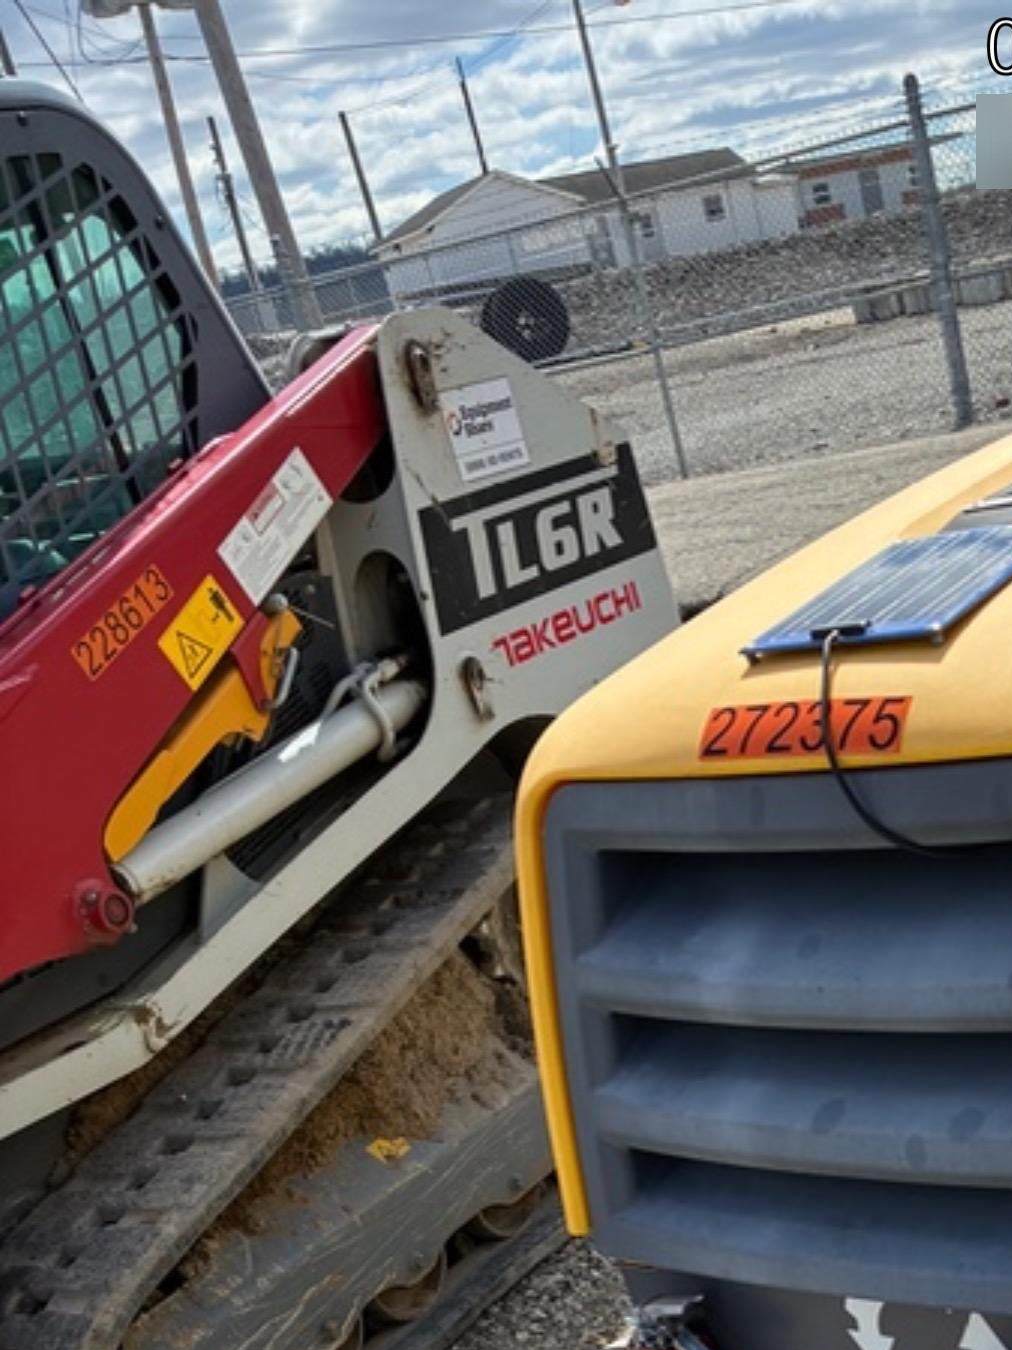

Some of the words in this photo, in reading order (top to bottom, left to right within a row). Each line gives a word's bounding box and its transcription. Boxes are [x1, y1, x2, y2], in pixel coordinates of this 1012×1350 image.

[452, 464, 624, 600] TL6R
[76, 568, 169, 675] 228613
[701, 697, 904, 756] 272375
